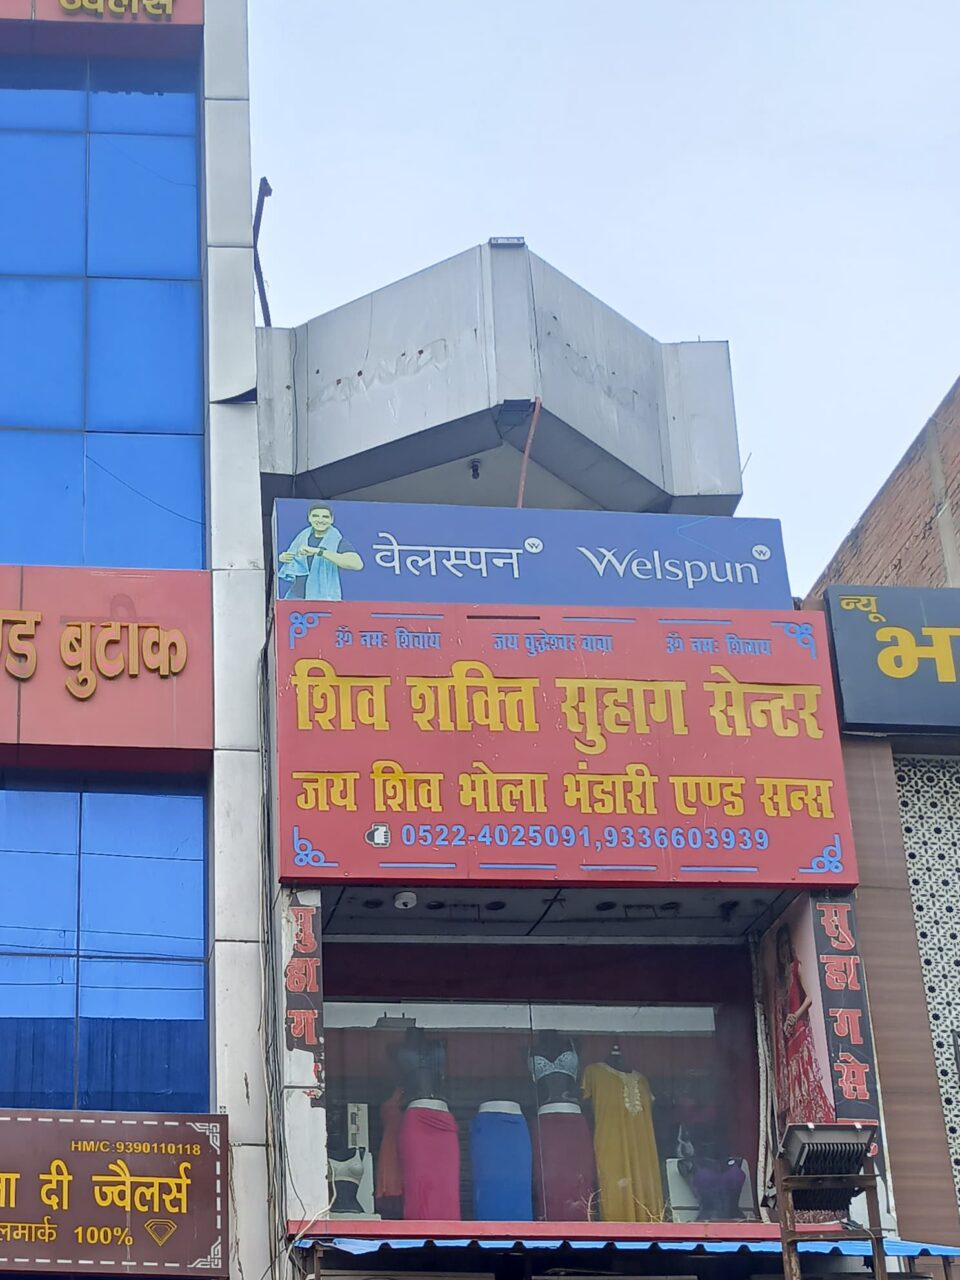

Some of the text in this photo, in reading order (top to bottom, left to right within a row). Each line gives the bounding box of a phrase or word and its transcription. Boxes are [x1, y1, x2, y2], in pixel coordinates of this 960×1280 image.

[373, 532, 523, 578] वेलस्पन
[576, 546, 759, 589] Welspun
[838, 595, 887, 622] न्यू
[359, 630, 388, 648] नमः
[394, 627, 441, 649] शिवाय
[492, 633, 519, 650] जय
[690, 637, 719, 654] नमः
[726, 633, 772, 656] शिवाय
[292, 658, 824, 755] शिव शक्ति सुहाग सेन्टर
[292, 760, 834, 818] जय शिव भोला भंडारी एण्ड सन्स
[401, 825, 769, 852] 0522-4025091,9336603939
[40, 1159, 73, 1210] दी
[92, 1159, 191, 1213] ज्वैलर्स
[74, 1226, 134, 1246] 100%
